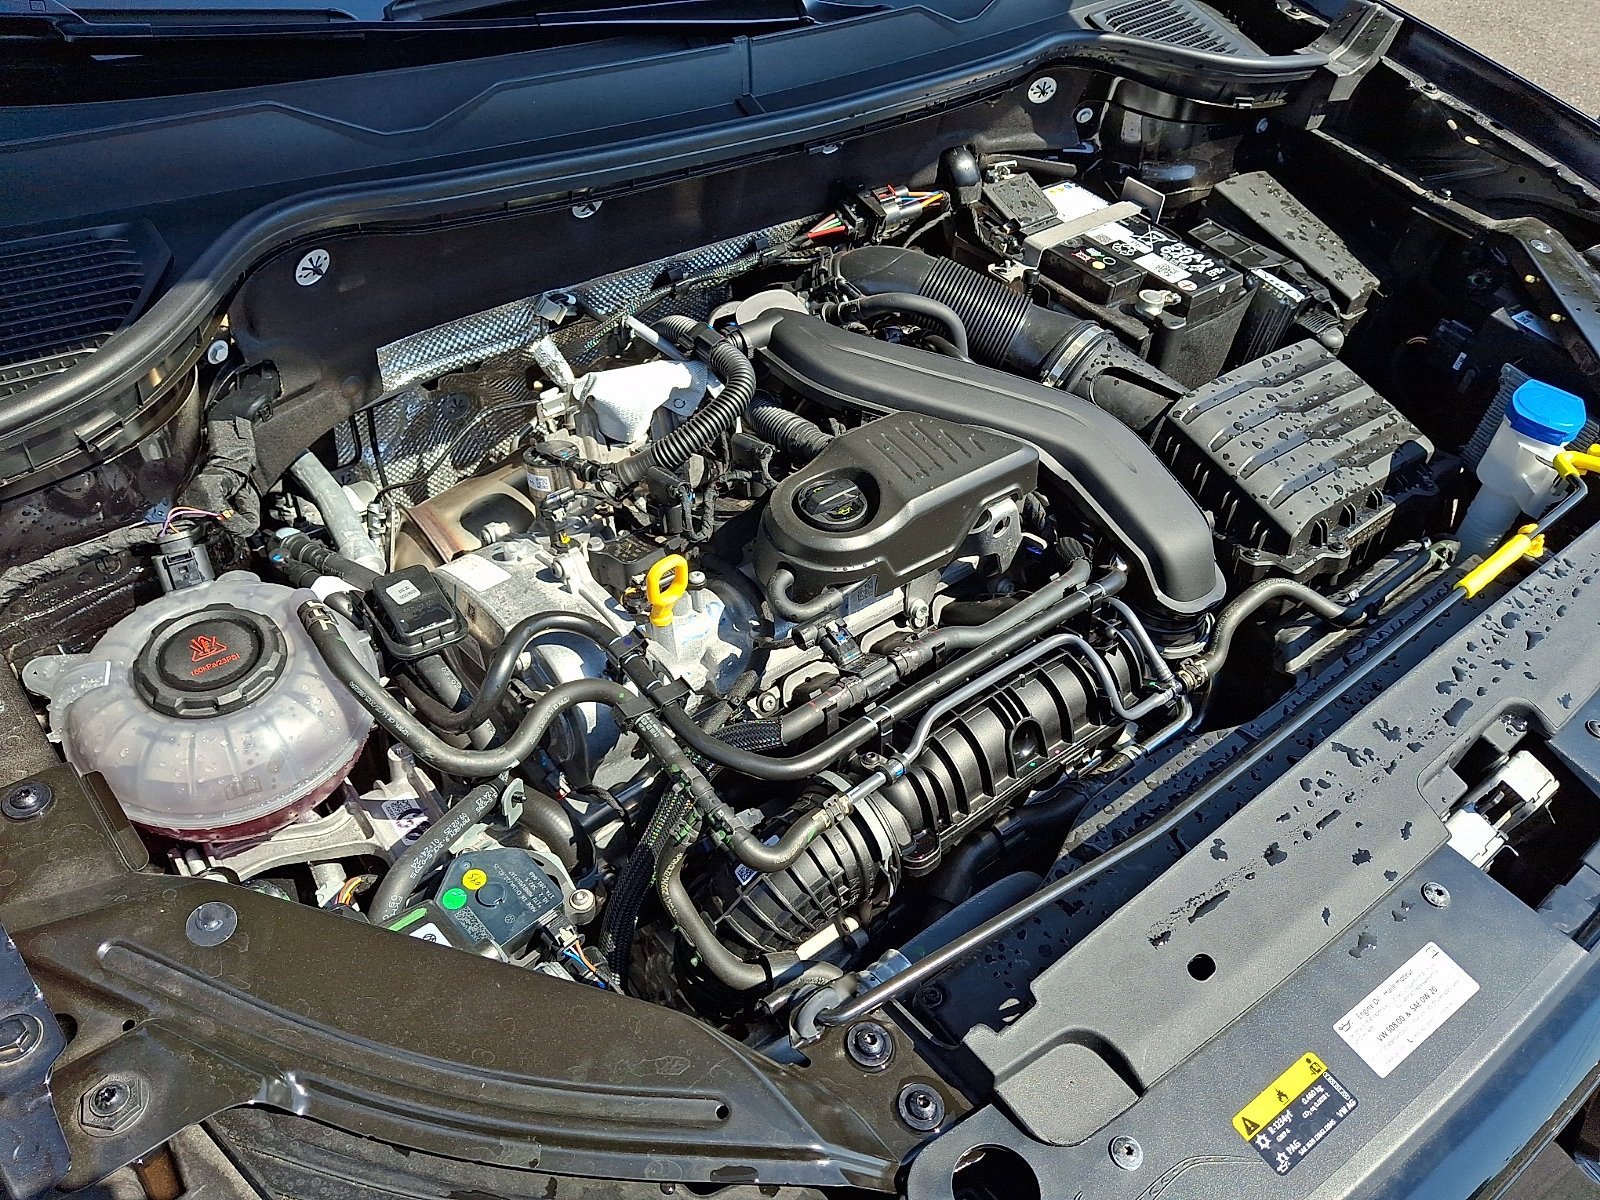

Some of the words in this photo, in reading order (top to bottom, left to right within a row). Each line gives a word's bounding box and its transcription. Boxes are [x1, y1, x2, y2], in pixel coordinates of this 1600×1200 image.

[1356, 1003, 1375, 1019] Engine
[1376, 1030, 1388, 1042] VW
[1385, 1021, 1399, 1034] 508
[1396, 1015, 1406, 1025] 00
[1409, 1000, 1422, 1012] SAE
[1428, 985, 1438, 996] 20
[1336, 1107, 1348, 1118] VW
[1345, 1098, 1357, 1110] AG
[1267, 1109, 1294, 1135] R-1234yf
[1285, 1139, 1302, 1155] PAG
